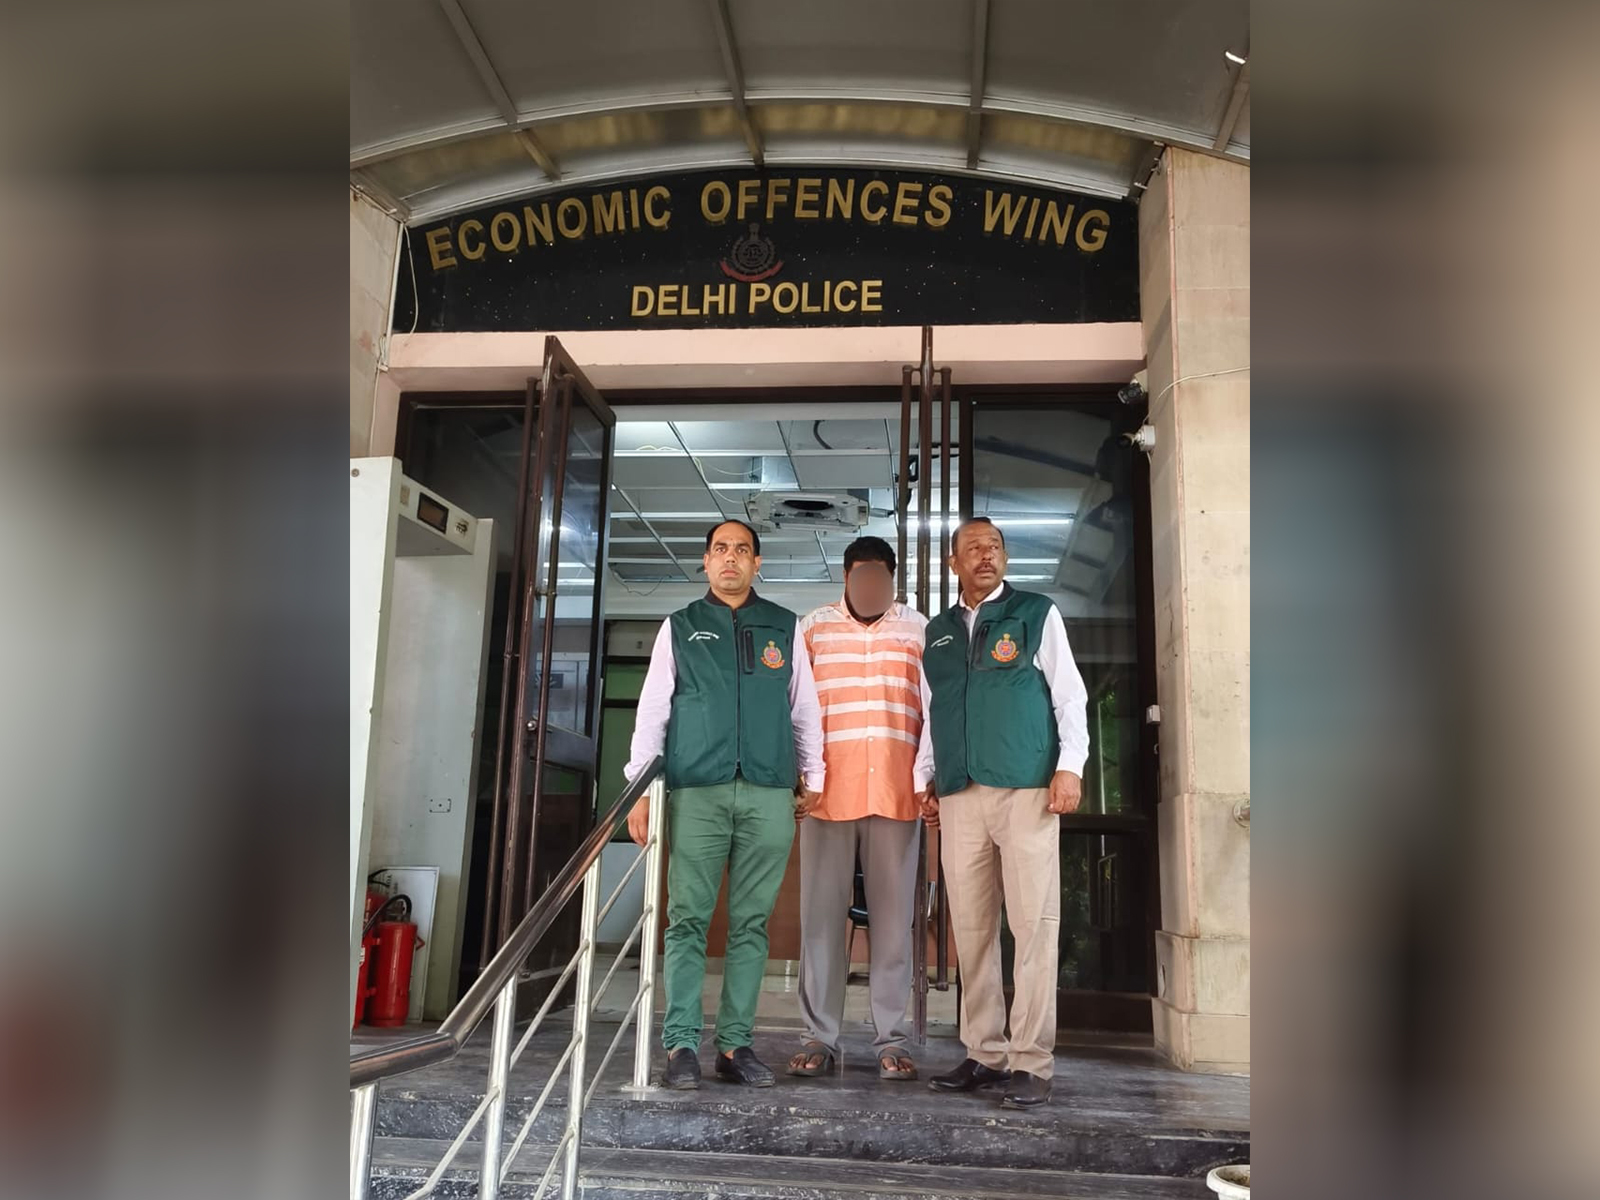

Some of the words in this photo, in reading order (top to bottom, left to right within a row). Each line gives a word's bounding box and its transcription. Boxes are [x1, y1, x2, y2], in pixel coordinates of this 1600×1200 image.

[426, 185, 671, 270] ECONOMIC
[701, 178, 953, 225] OFFENCES
[984, 190, 1111, 252] WING
[631, 284, 735, 316] DELHI
[749, 279, 883, 313] POLICE
